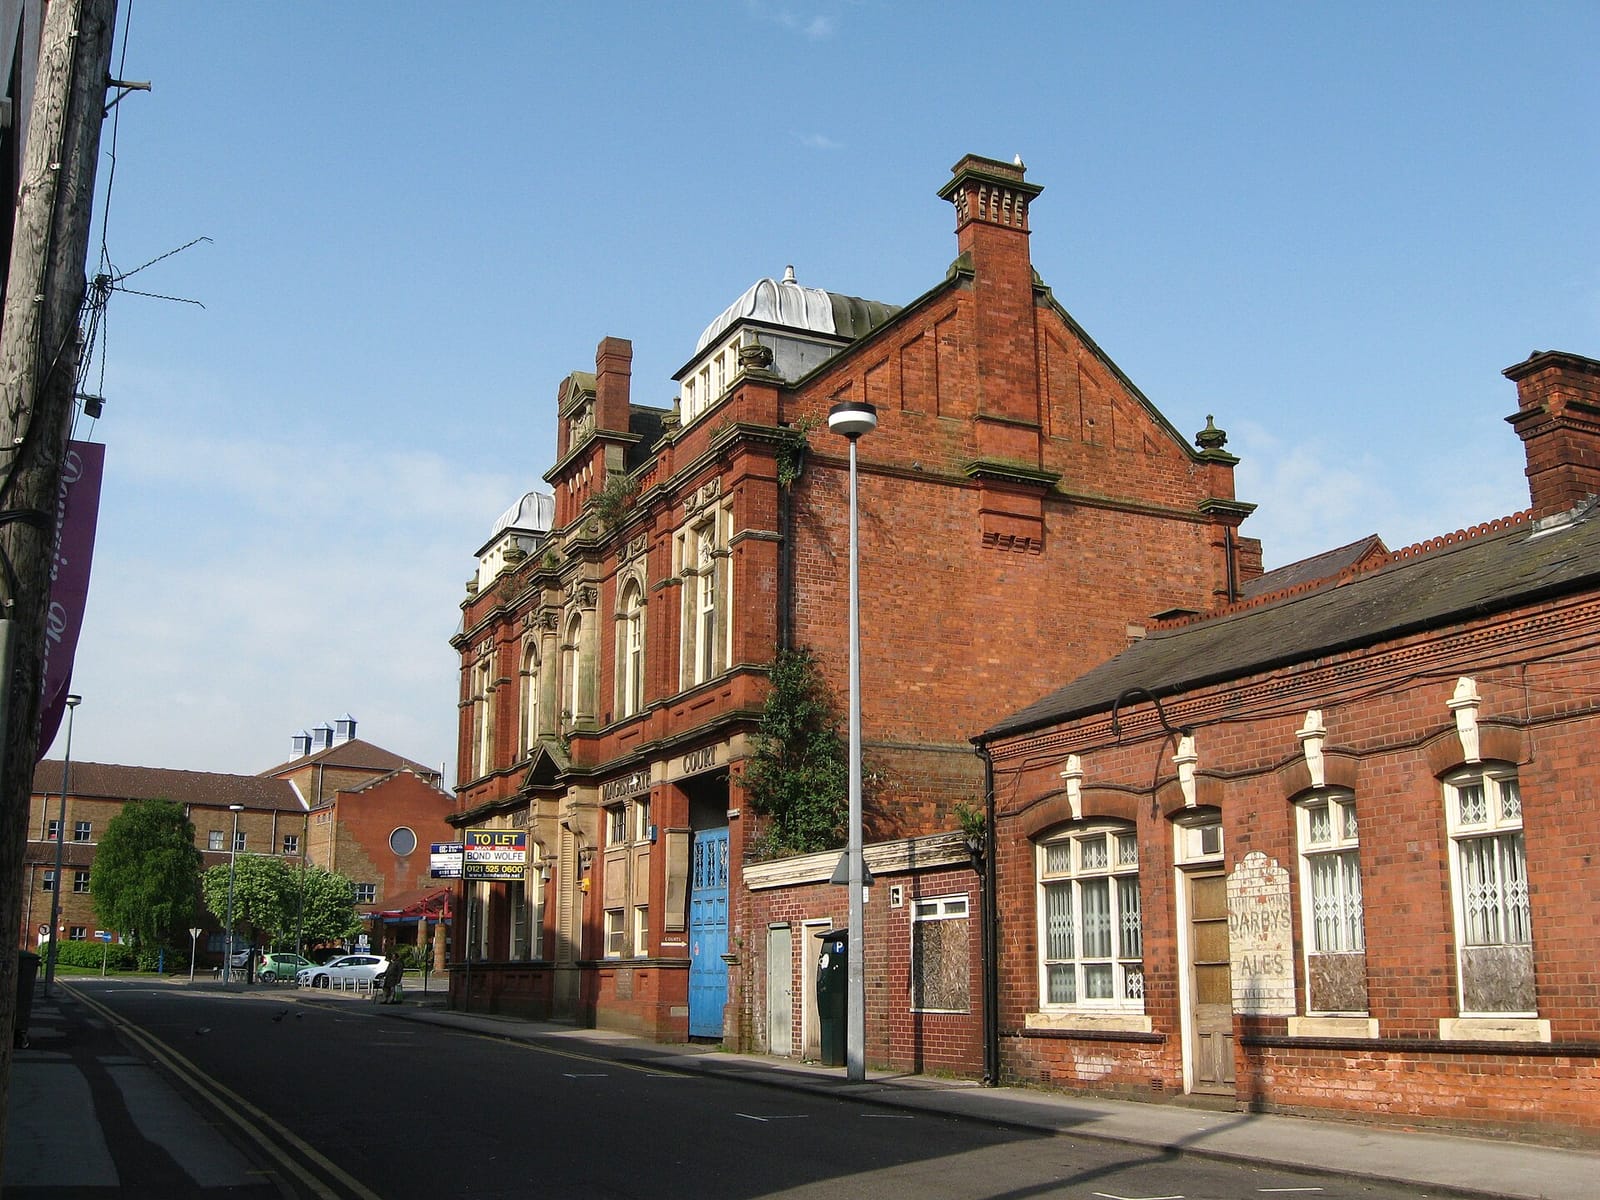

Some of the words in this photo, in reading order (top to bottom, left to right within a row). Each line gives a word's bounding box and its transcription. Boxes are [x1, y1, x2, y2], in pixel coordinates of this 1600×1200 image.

[683, 746, 717, 773] COURT
[473, 834, 491, 845] TO
[495, 834, 518, 845] LET
[467, 852, 491, 860] BOND
[494, 852, 523, 860] WOLFE
[485, 865, 499, 873] 525
[1229, 905, 1290, 932] DARBYS
[1241, 953, 1285, 977] ALES
